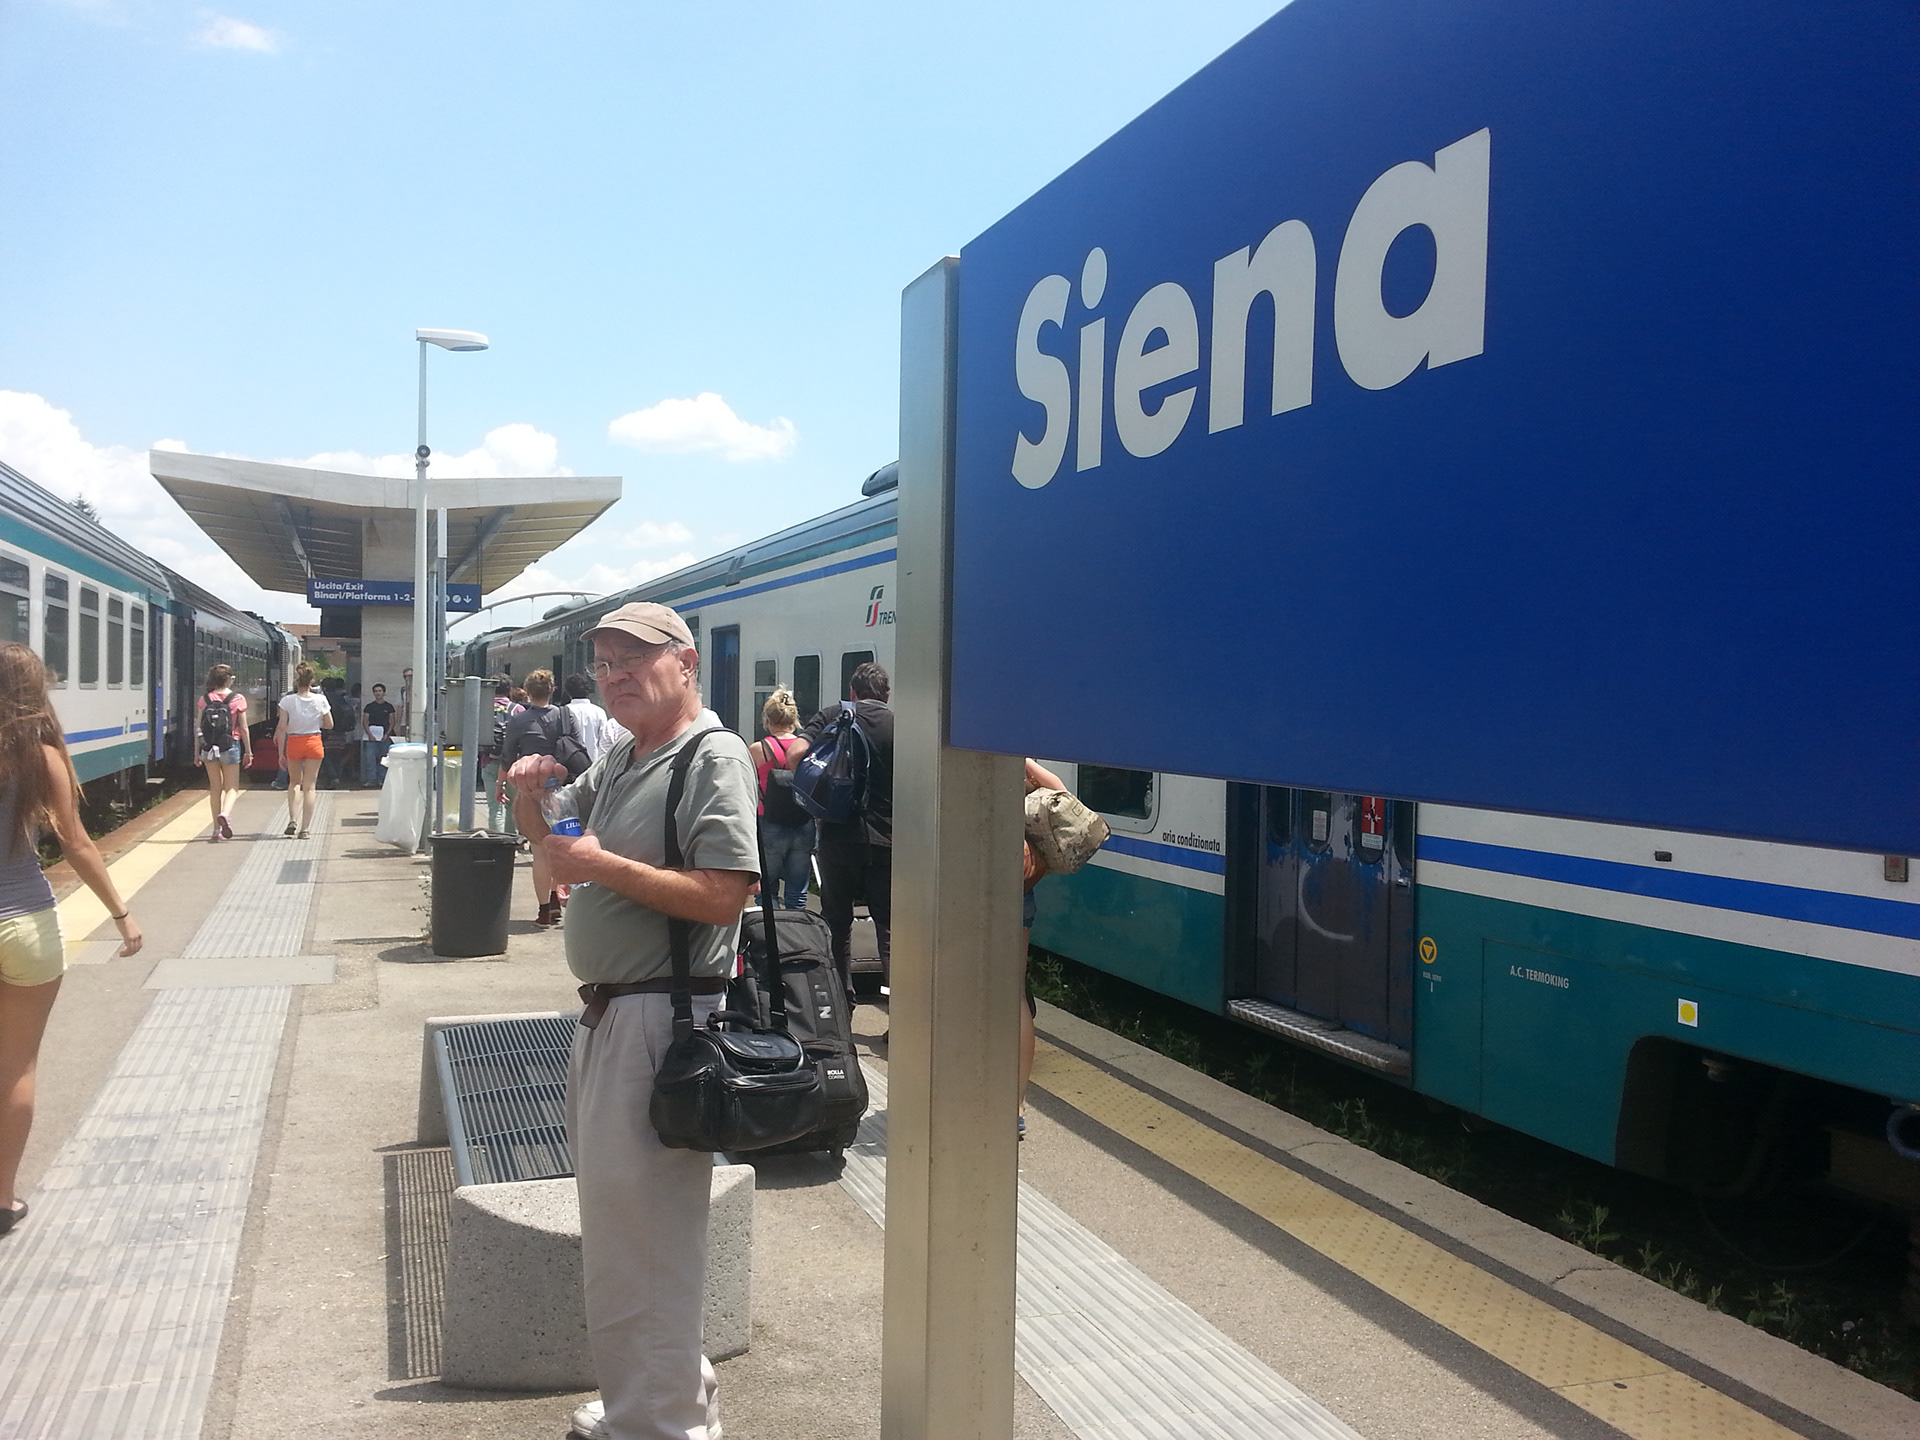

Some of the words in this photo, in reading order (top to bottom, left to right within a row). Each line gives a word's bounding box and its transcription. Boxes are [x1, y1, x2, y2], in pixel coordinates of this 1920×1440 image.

[1011, 126, 1491, 490] Siena
[314, 581, 364, 591] Uscita/Exit
[314, 591, 391, 601] Binari/Platforms
[1162, 829, 1176, 844] aria
[1177, 832, 1221, 852] condizionata
[1510, 965, 1524, 978] A.C.
[1525, 968, 1570, 989] TERMOKING
